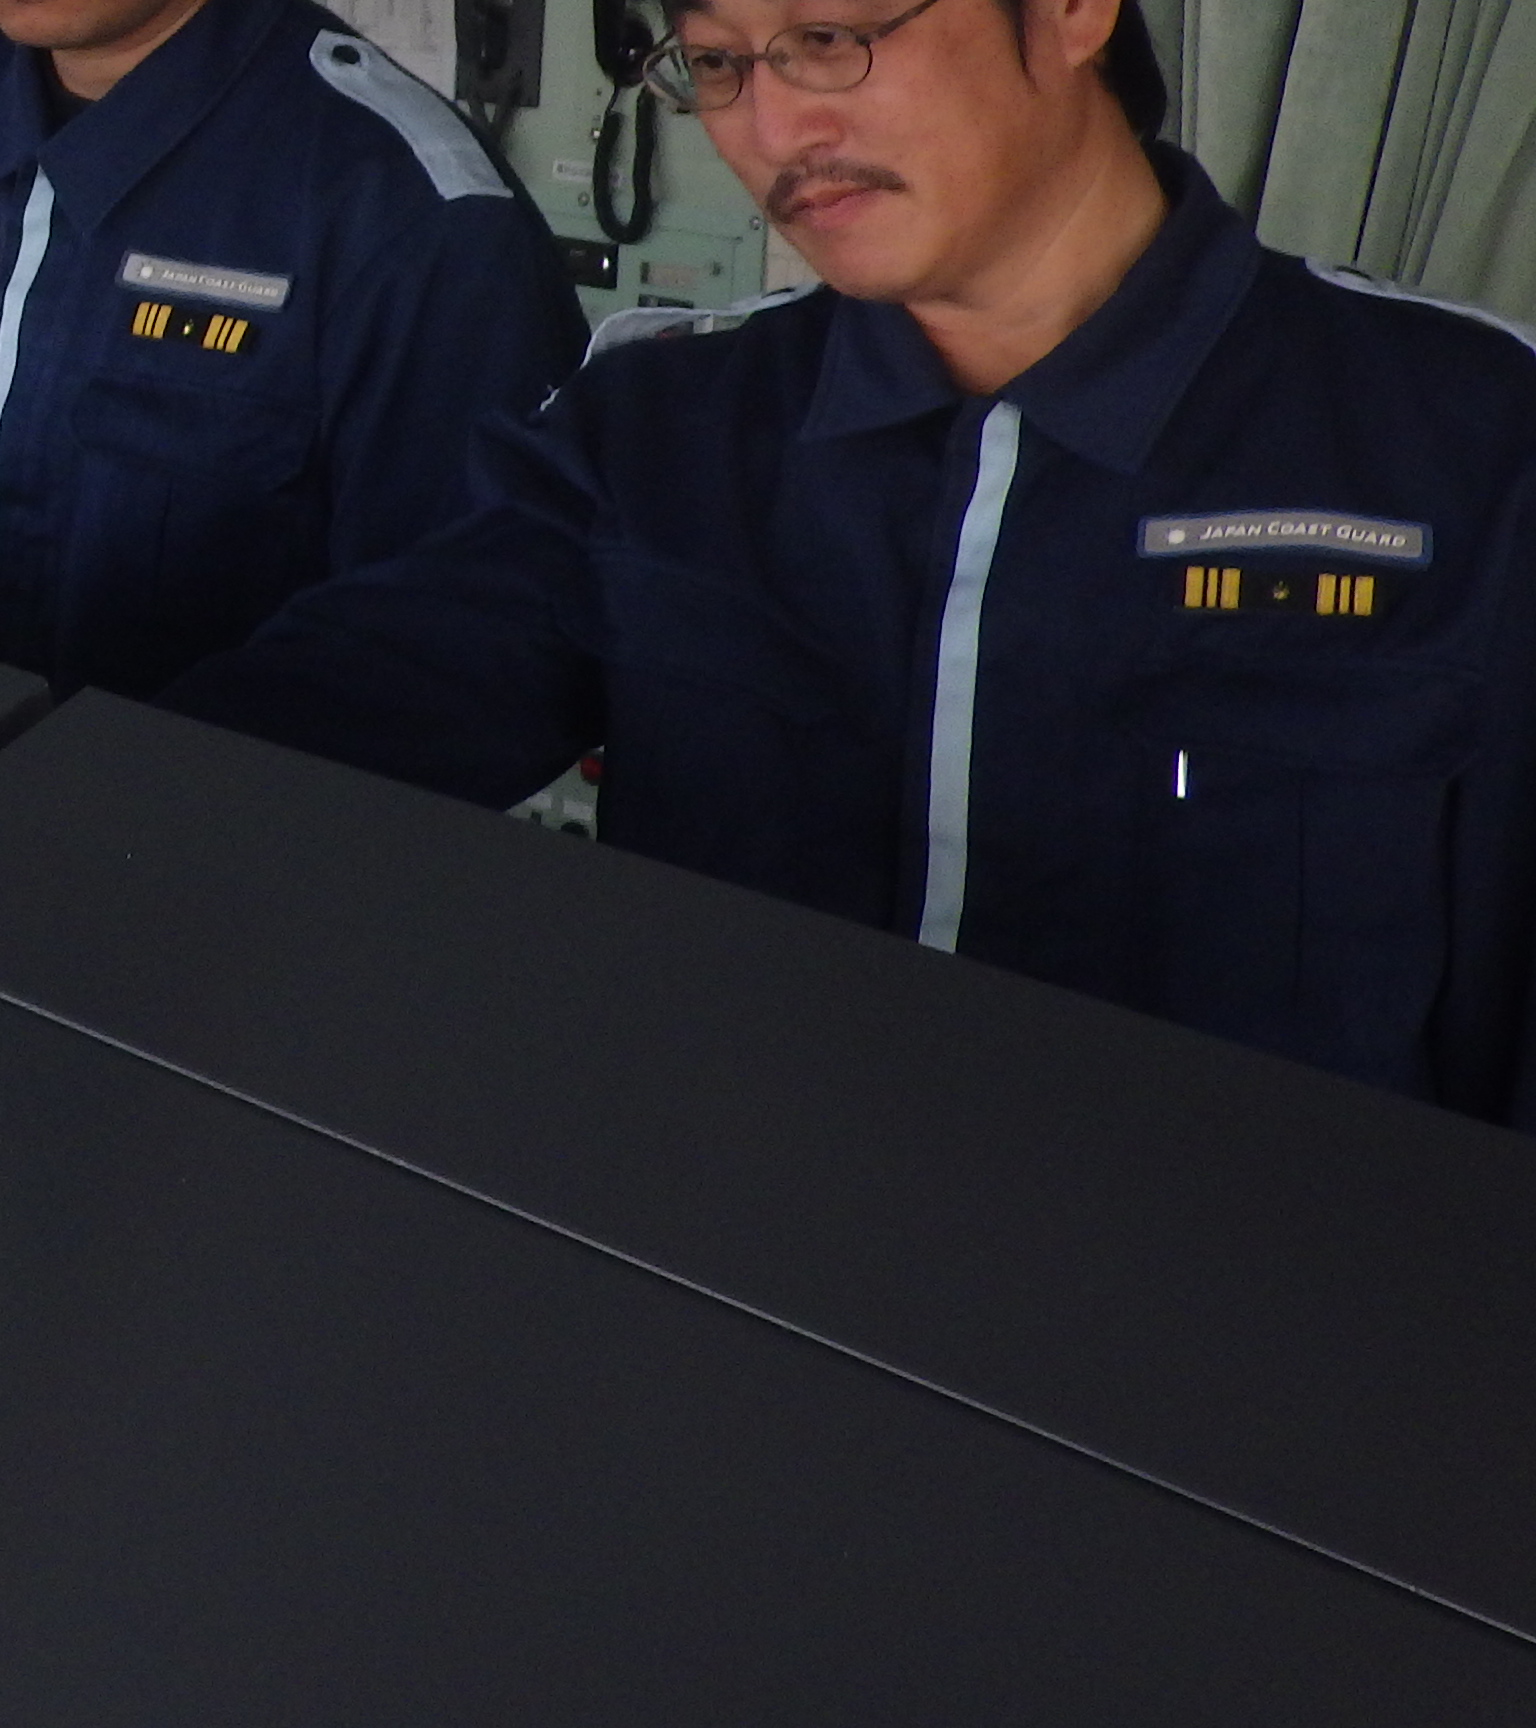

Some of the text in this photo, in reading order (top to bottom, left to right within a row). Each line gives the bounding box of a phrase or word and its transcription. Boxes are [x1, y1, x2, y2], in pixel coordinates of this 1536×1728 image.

[238, 280, 279, 298] GUARD
[1199, 520, 1407, 548] JAPAN COAST GUARD
